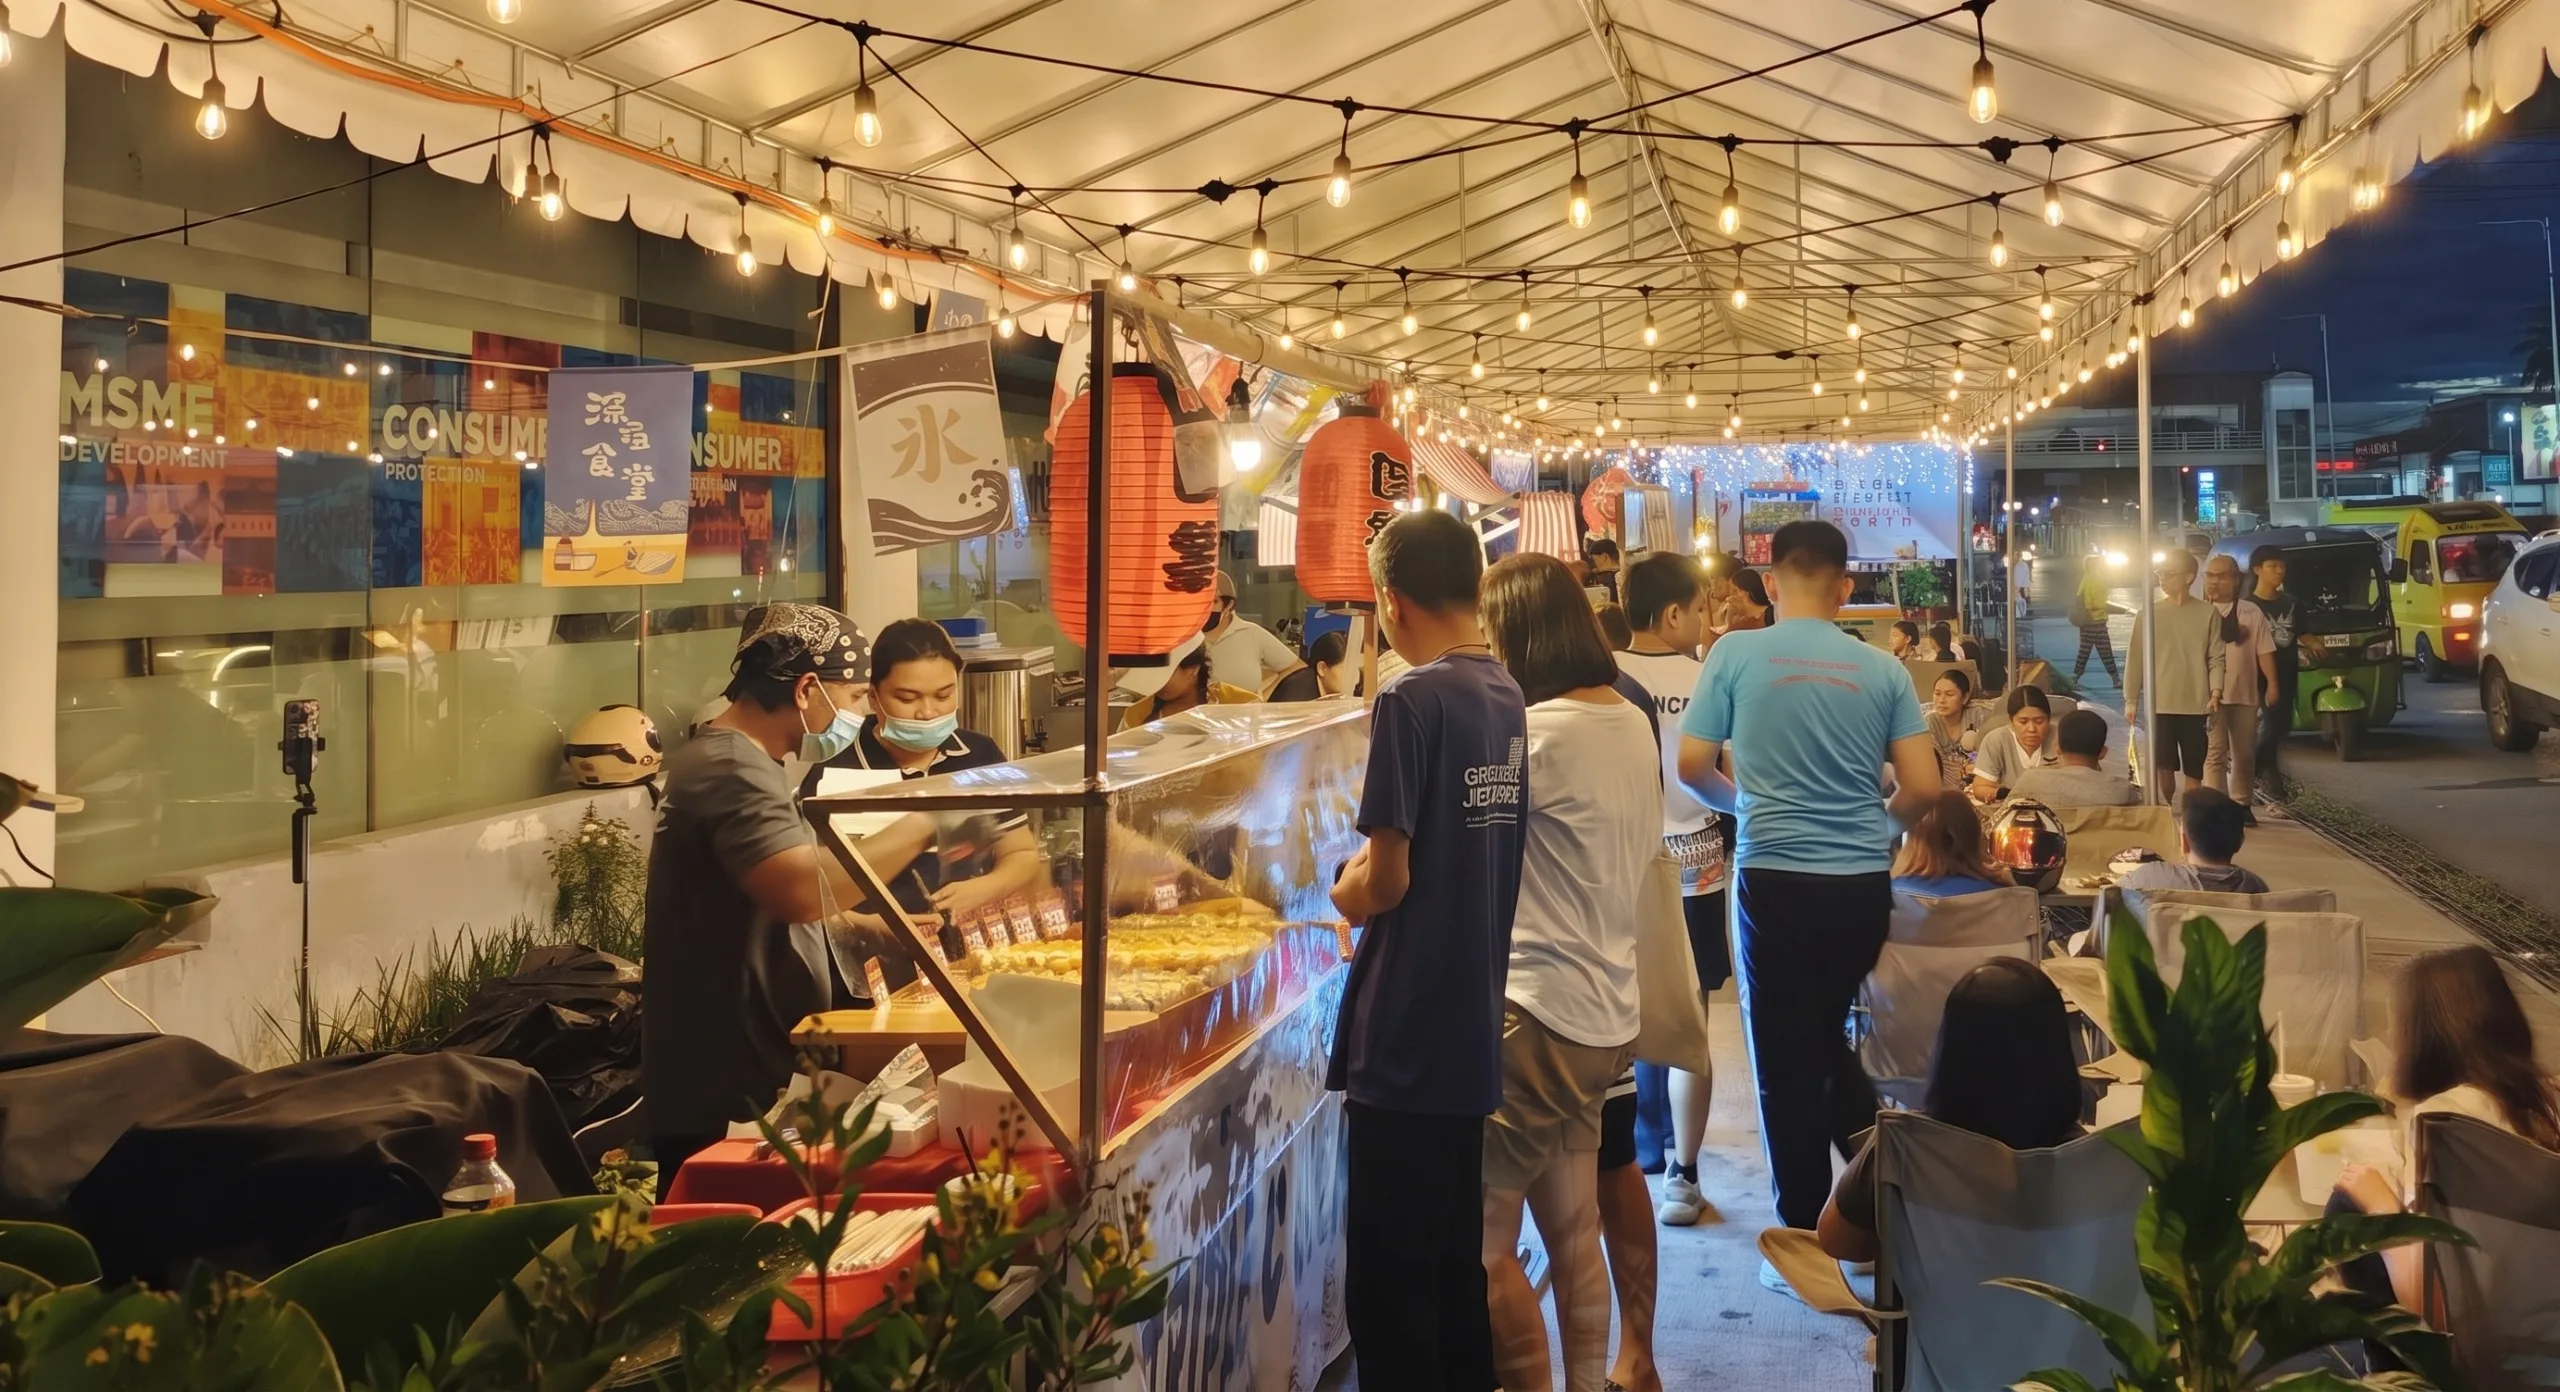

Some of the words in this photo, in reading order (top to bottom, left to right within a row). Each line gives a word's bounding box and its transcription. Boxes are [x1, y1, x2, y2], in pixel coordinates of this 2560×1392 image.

[60, 371, 214, 435] MSME
[60, 441, 228, 469] DEVELOPMENT
[889, 404, 979, 483] 氷
[385, 462, 485, 483] PROTECTION
